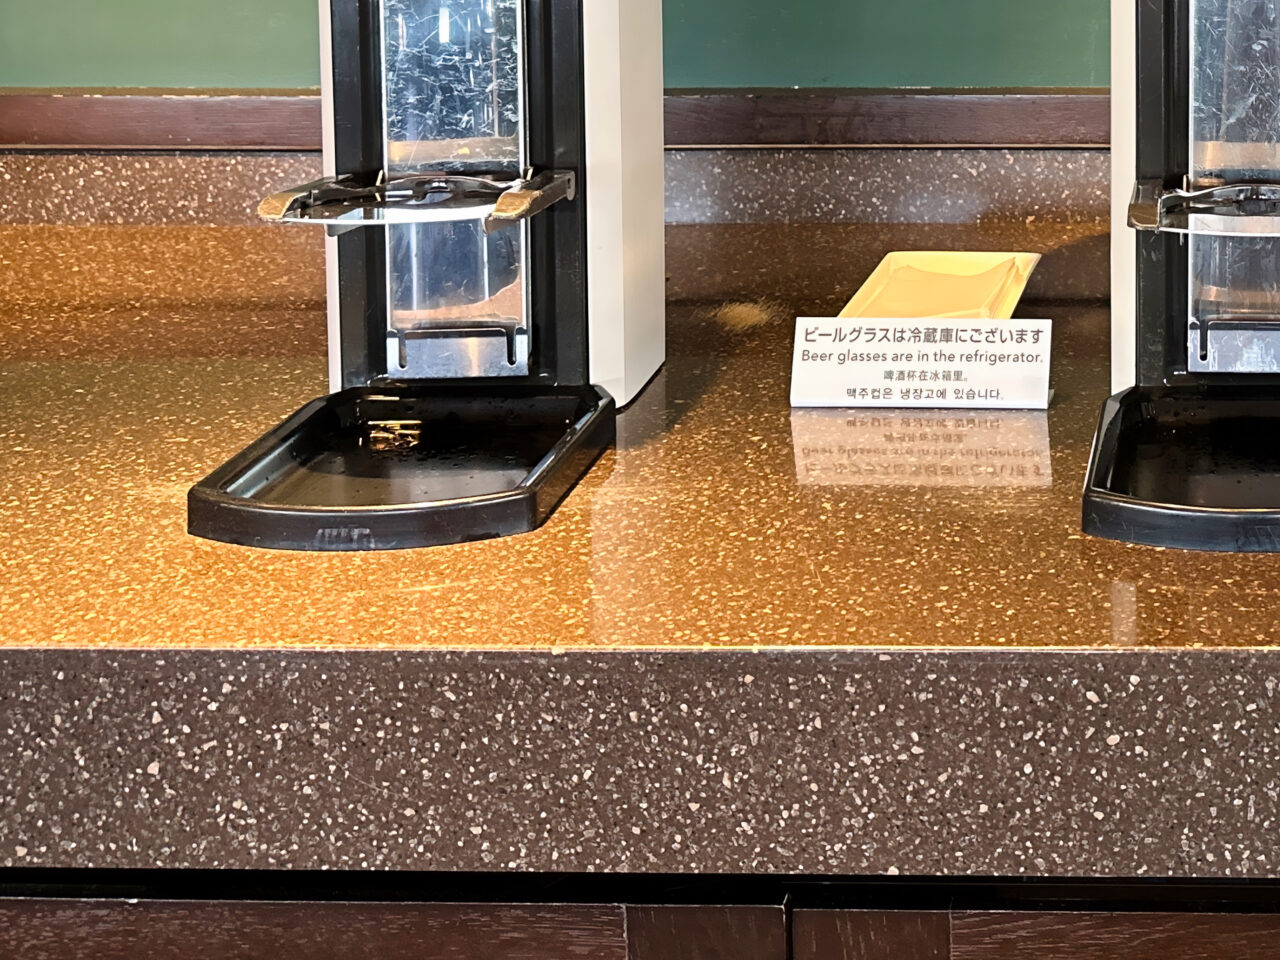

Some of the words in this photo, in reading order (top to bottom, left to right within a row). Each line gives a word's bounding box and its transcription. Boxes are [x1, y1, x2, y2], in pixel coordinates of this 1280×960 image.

[804, 326, 1045, 344] ビールグラスは冷蔵庫にございます
[801, 350, 834, 362] Beer
[838, 349, 888, 365] glasses
[891, 352, 914, 362] are
[917, 350, 929, 362] in
[933, 350, 956, 362] the
[959, 350, 1044, 366] refrigerator.
[883, 370, 968, 382] 啤酒杯在冰箱里。
[846, 388, 894, 400] 맥주컵은
[900, 388, 948, 400] 냉장고에
[954, 388, 1004, 401] 있습니다.
